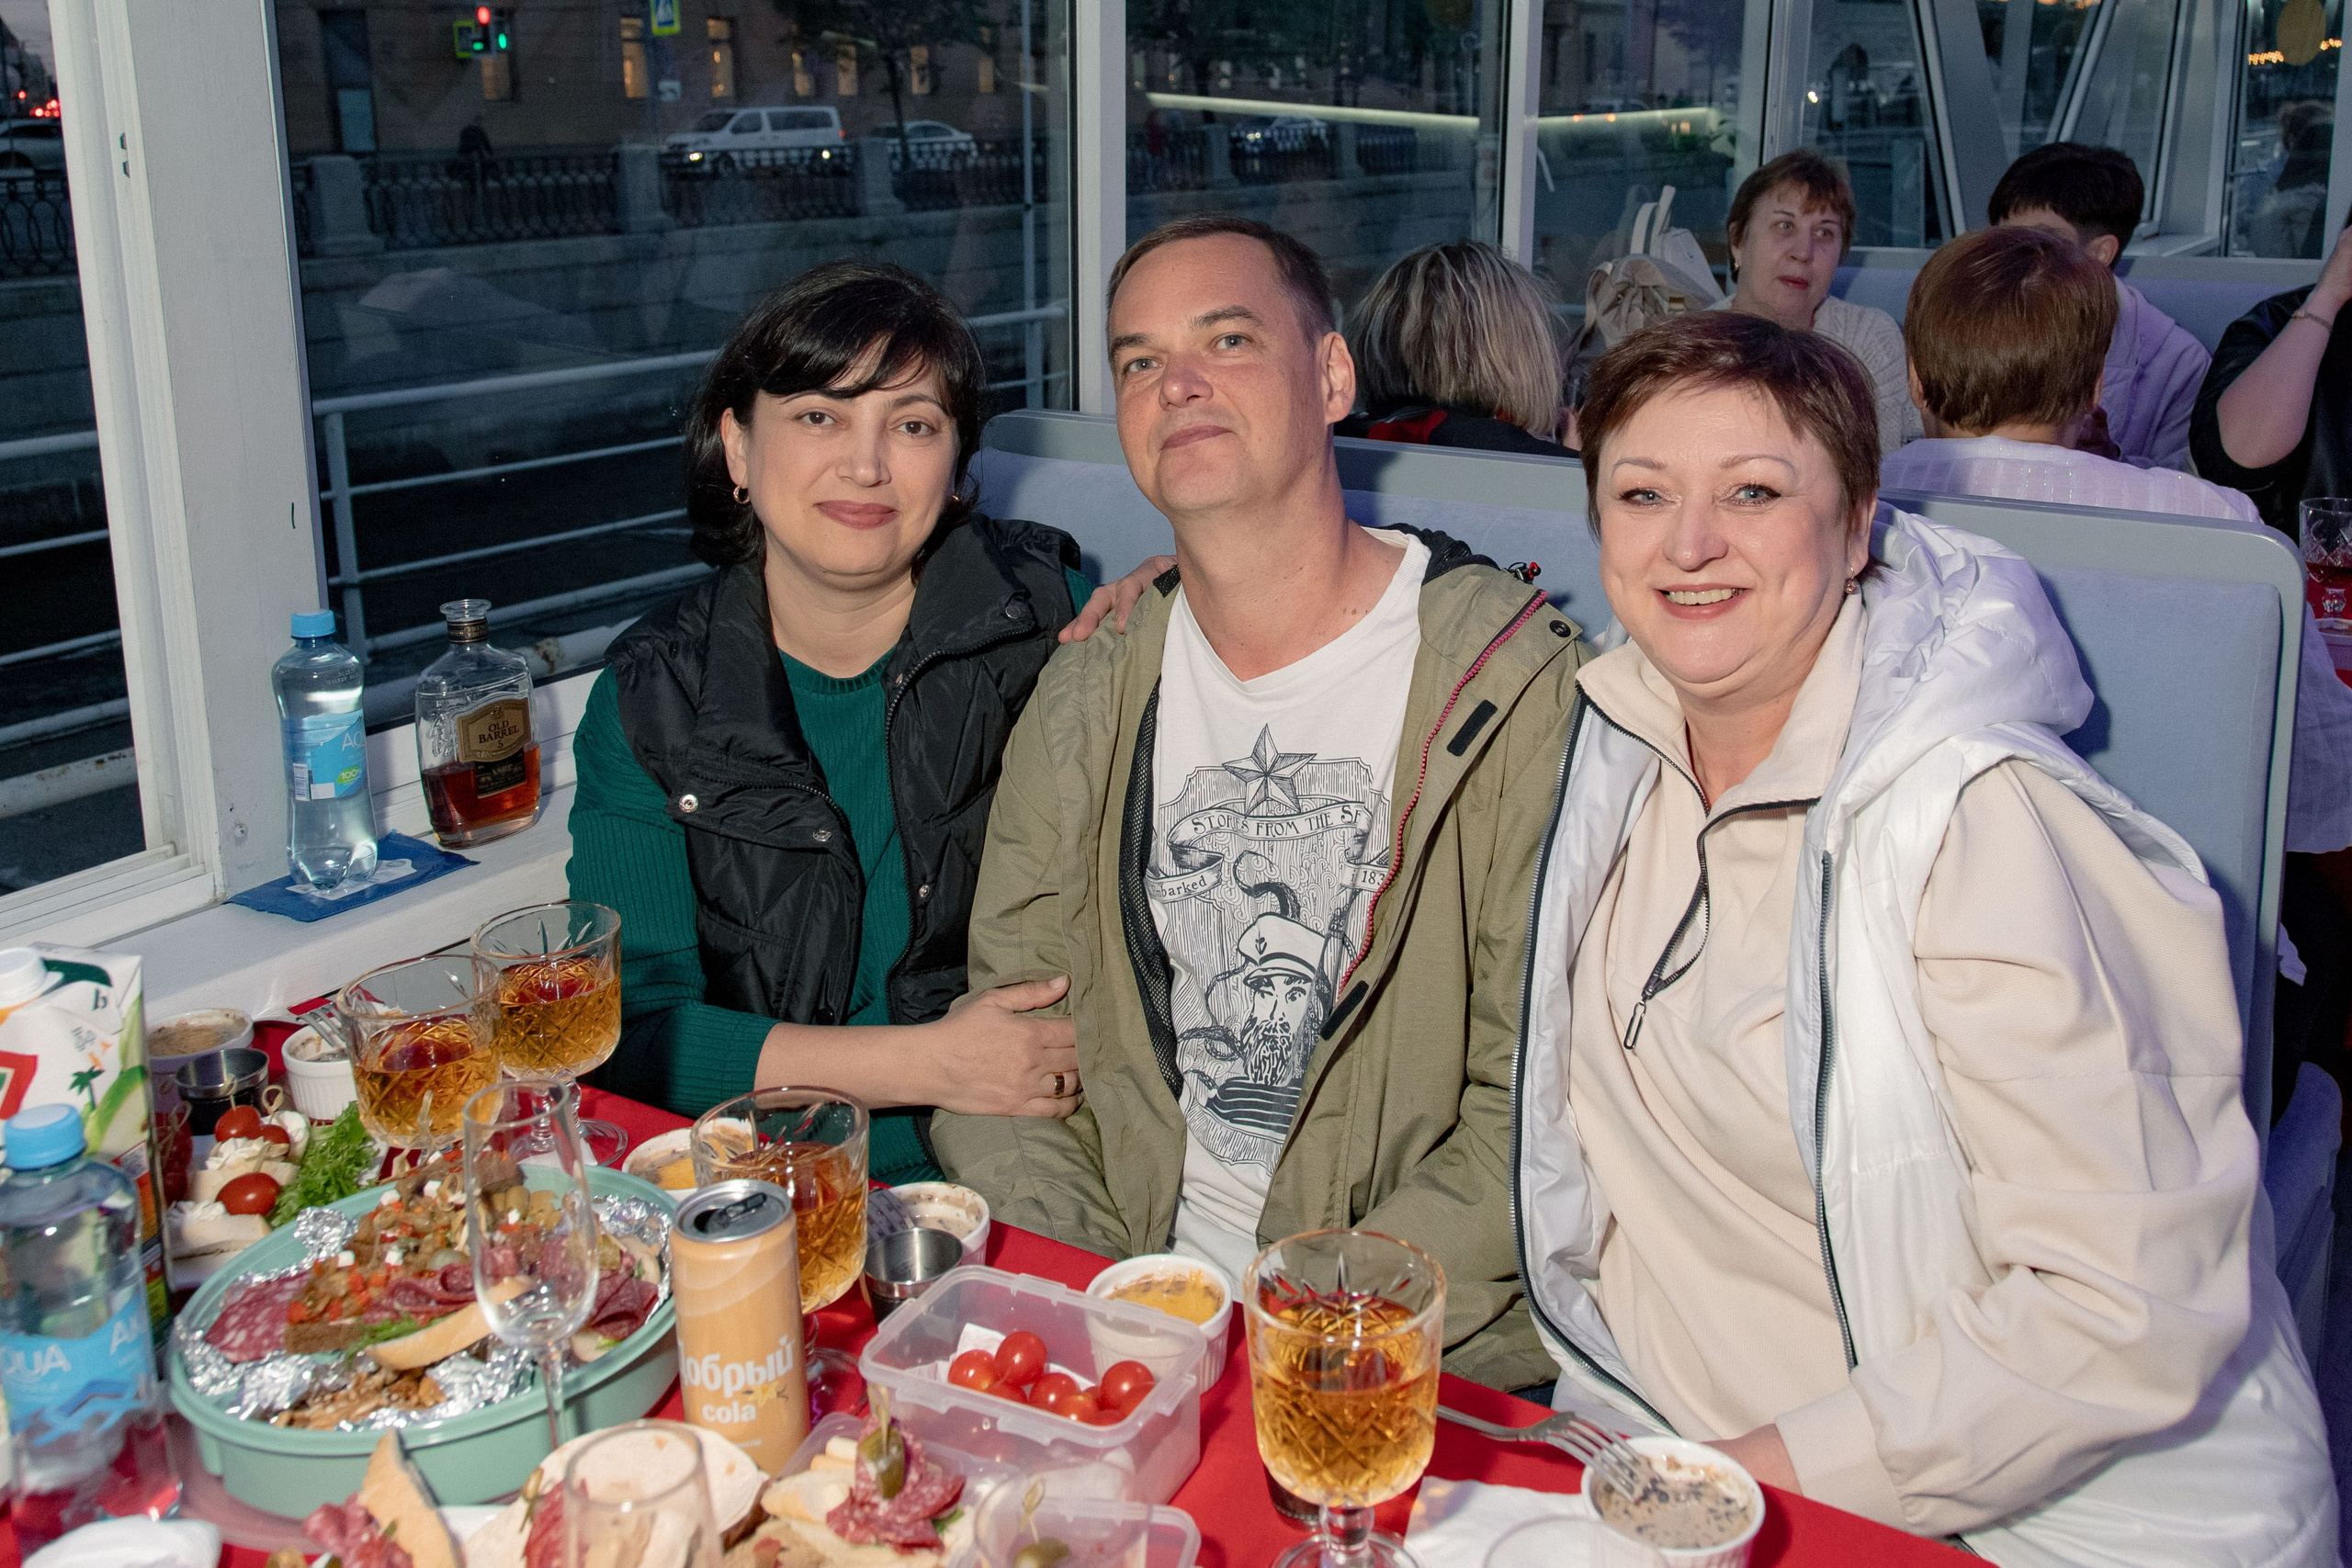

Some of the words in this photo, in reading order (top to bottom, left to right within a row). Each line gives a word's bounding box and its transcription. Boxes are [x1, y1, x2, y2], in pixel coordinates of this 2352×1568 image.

[479, 726, 519, 744] BARREL
[488, 720, 510, 732] OLD
[497, 740, 503, 749] 5
[1192, 814, 1250, 835] STORIES
[1256, 820, 1300, 838] FROM
[1305, 811, 1332, 831] THE
[702, 1400, 757, 1424] cola
